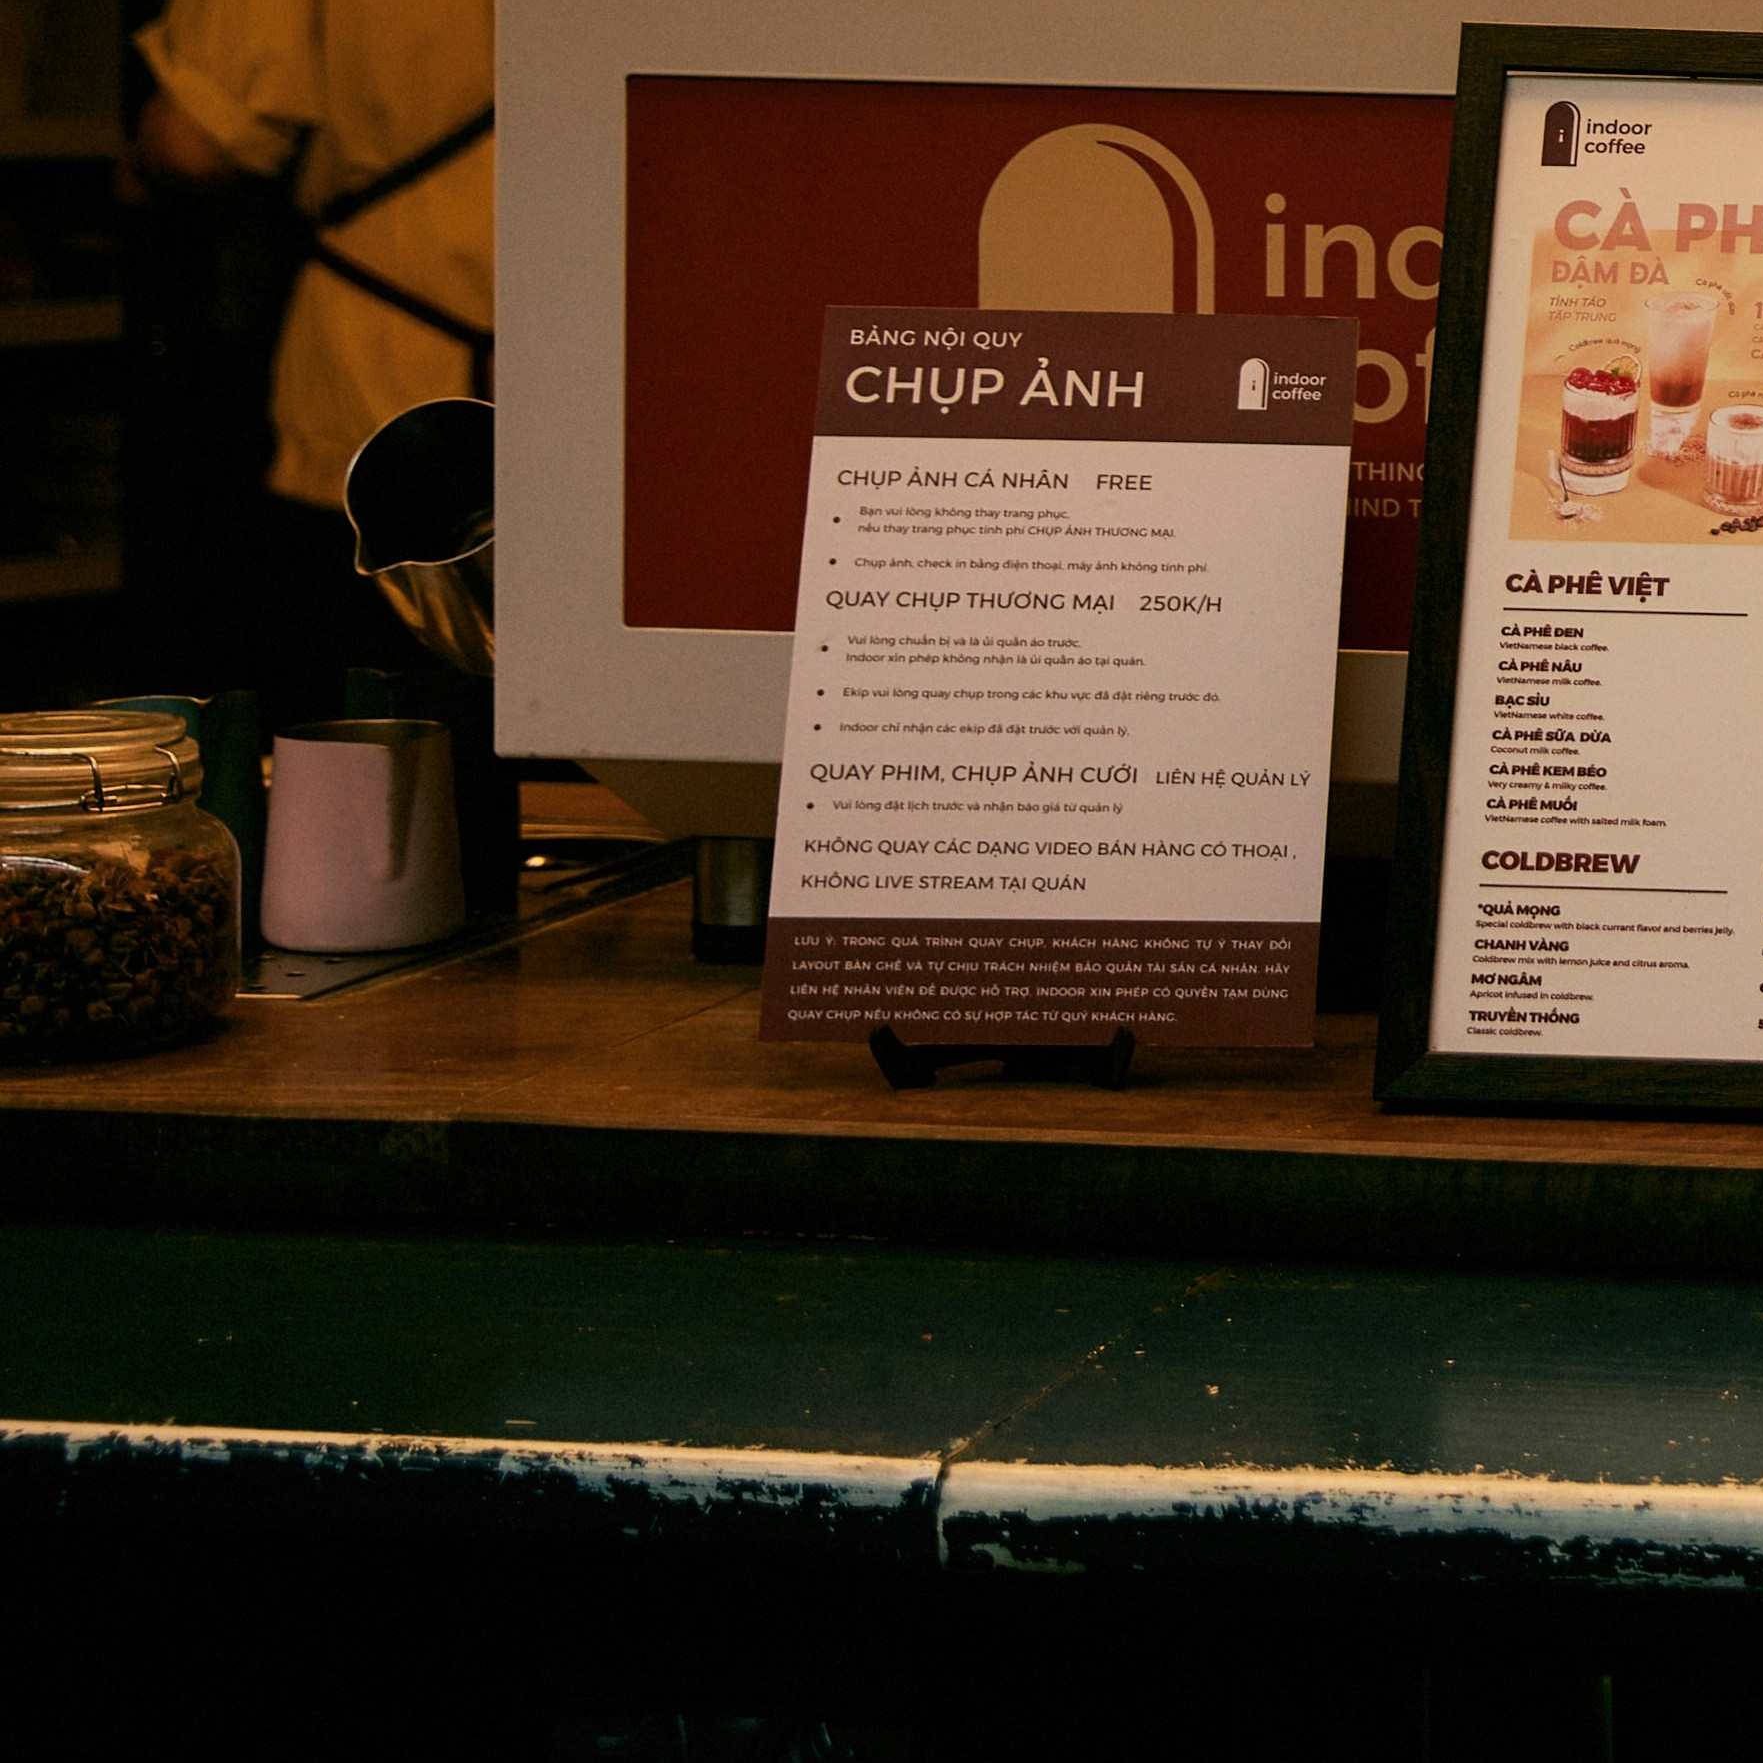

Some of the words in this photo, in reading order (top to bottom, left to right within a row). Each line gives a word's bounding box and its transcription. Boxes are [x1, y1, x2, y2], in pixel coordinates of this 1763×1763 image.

[1587, 119, 1652, 135] indoor
[1584, 138, 1645, 154] coffee
[1554, 187, 1653, 252] CÀ
[850, 325, 915, 346] BẢNG
[924, 327, 965, 351] NỘI
[973, 331, 1022, 350] QUY
[846, 366, 1004, 414] CHỤP
[1020, 357, 1143, 407] ẢNH
[1274, 372, 1326, 385] indoor
[1272, 387, 1321, 400] coffee
[837, 470, 902, 490] CHỤP
[907, 466, 957, 487] ẢNH
[964, 469, 995, 487] CÁ
[1002, 473, 1068, 489] NHÂN
[1097, 474, 1152, 491] FREE
[1506, 569, 1543, 593] CÀ
[1548, 570, 1603, 594] PHÊ
[1608, 572, 1670, 603] VIỆT
[826, 591, 890, 609] QUAY
[896, 591, 960, 612] CHỤP
[967, 591, 1065, 610] THƯƠNG
[1073, 594, 1114, 614] MẠI
[1140, 595, 1222, 614] 250K/H
[1501, 624, 1521, 636] CÀ
[1523, 624, 1552, 637] PHÊ
[1554, 628, 1584, 638] ĐEN
[810, 764, 875, 783] QUAY
[881, 764, 944, 782] PHIM,
[952, 765, 1017, 786] CHỤP
[1022, 761, 1073, 783] ẢNH
[1080, 764, 1137, 783] CƯỚI
[1156, 768, 1195, 784] LIÊN
[1201, 769, 1225, 788] HỆ
[1231, 769, 1284, 788] QUẢN
[1291, 770, 1311, 786] LÝ
[1482, 850, 1640, 874] COLDBREW
